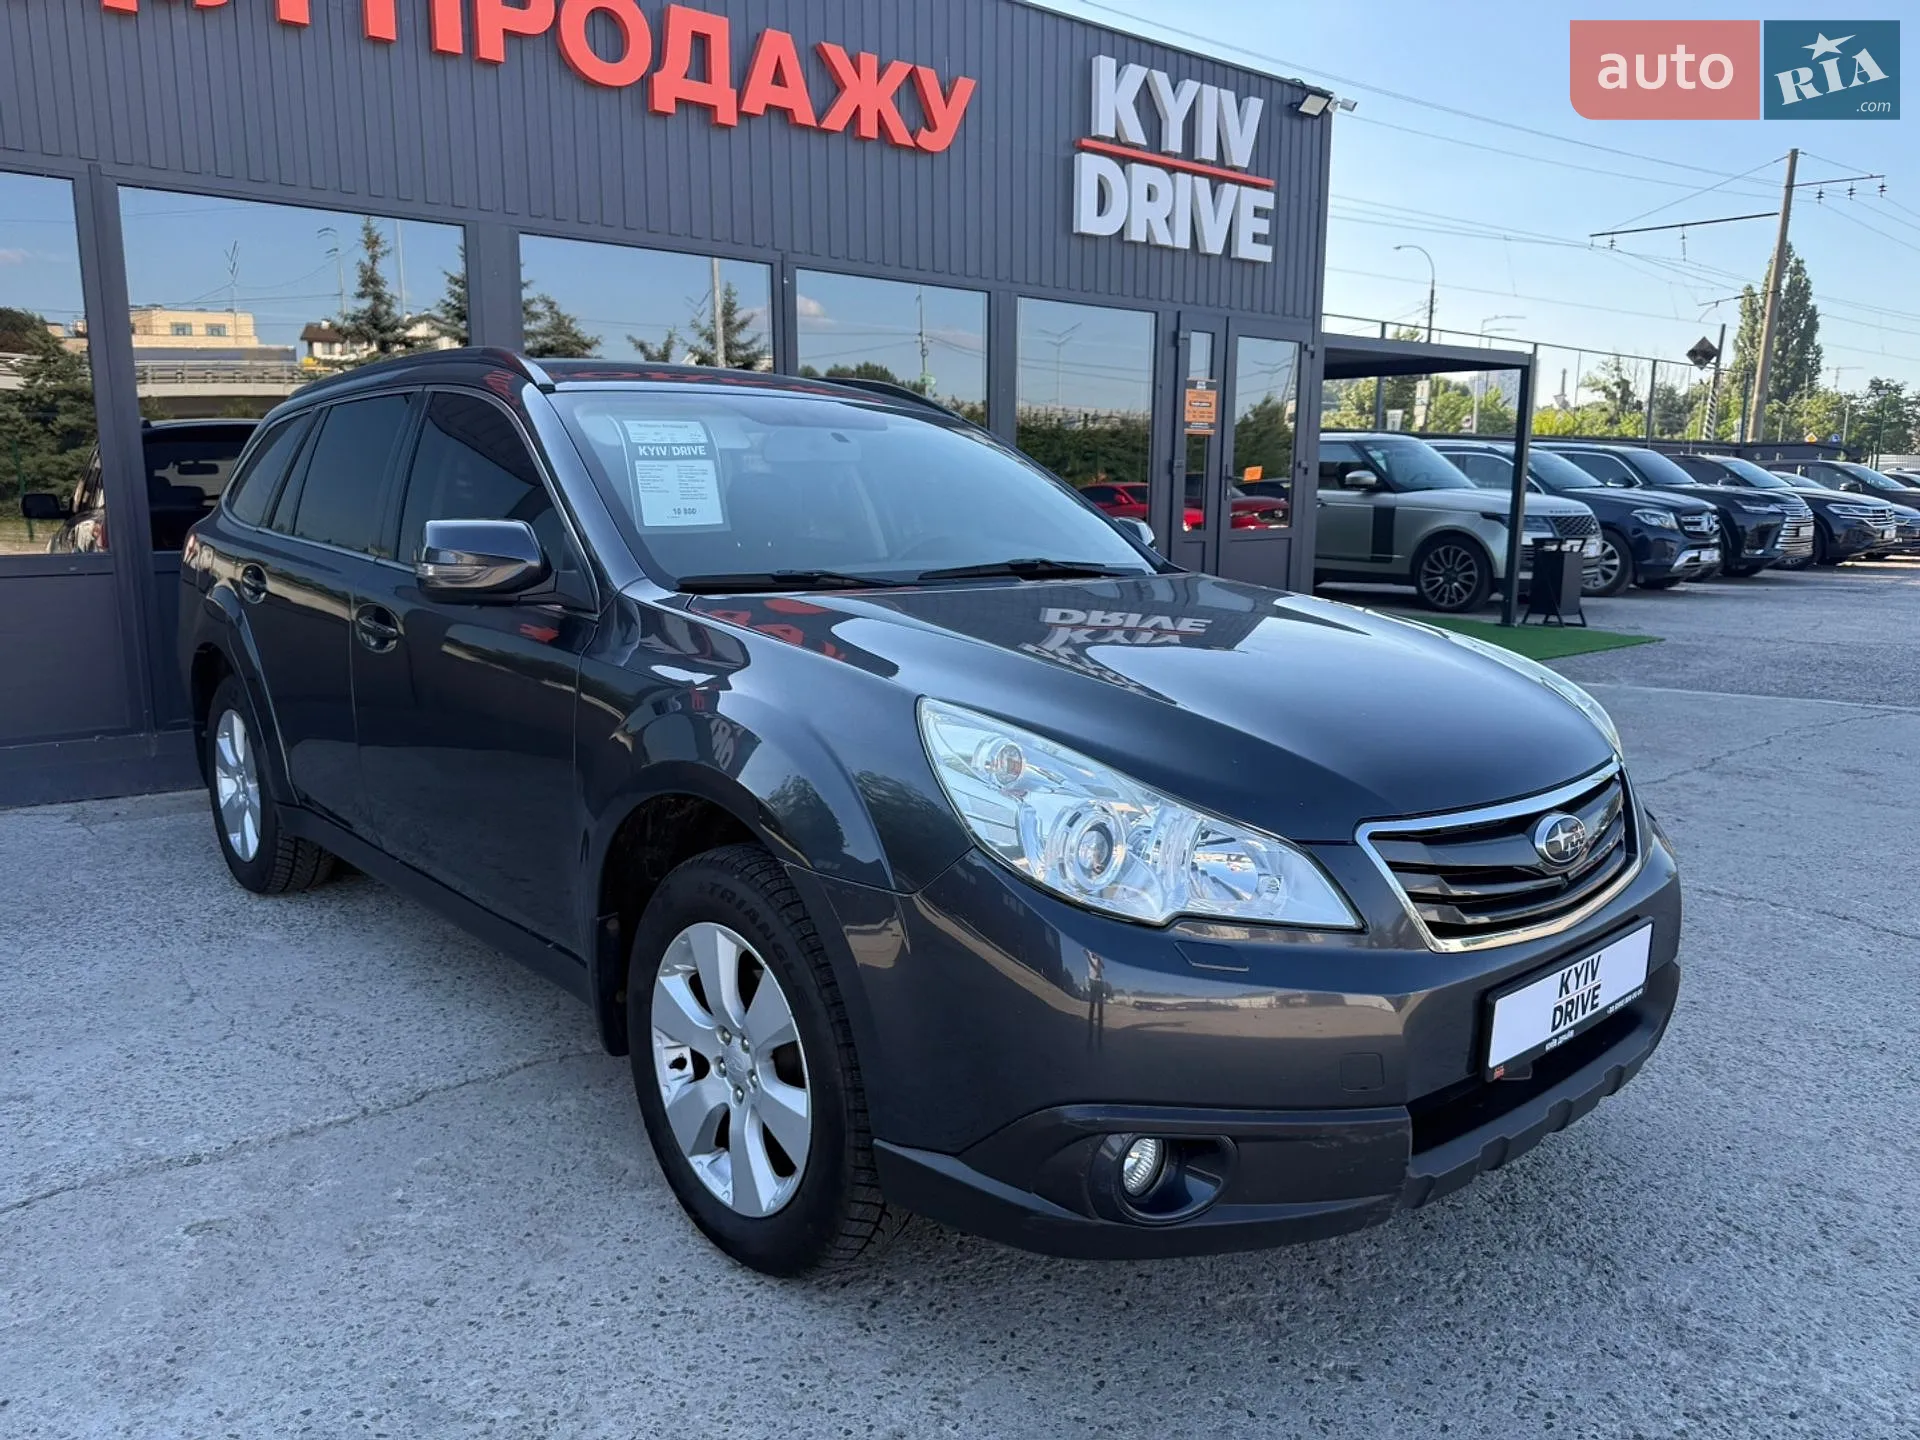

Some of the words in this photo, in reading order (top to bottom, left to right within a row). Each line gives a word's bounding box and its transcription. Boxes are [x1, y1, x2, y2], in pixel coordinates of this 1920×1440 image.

[1090, 54, 1264, 169] KYIV
[1073, 151, 1275, 263] DRIVE
[638, 445, 667, 456] KYIV
[672, 445, 707, 456] DRIVE
[708, 882, 811, 1006] TRIANGLE
[1558, 955, 1602, 999] KYIV
[1550, 983, 1602, 1033] DRIVE
